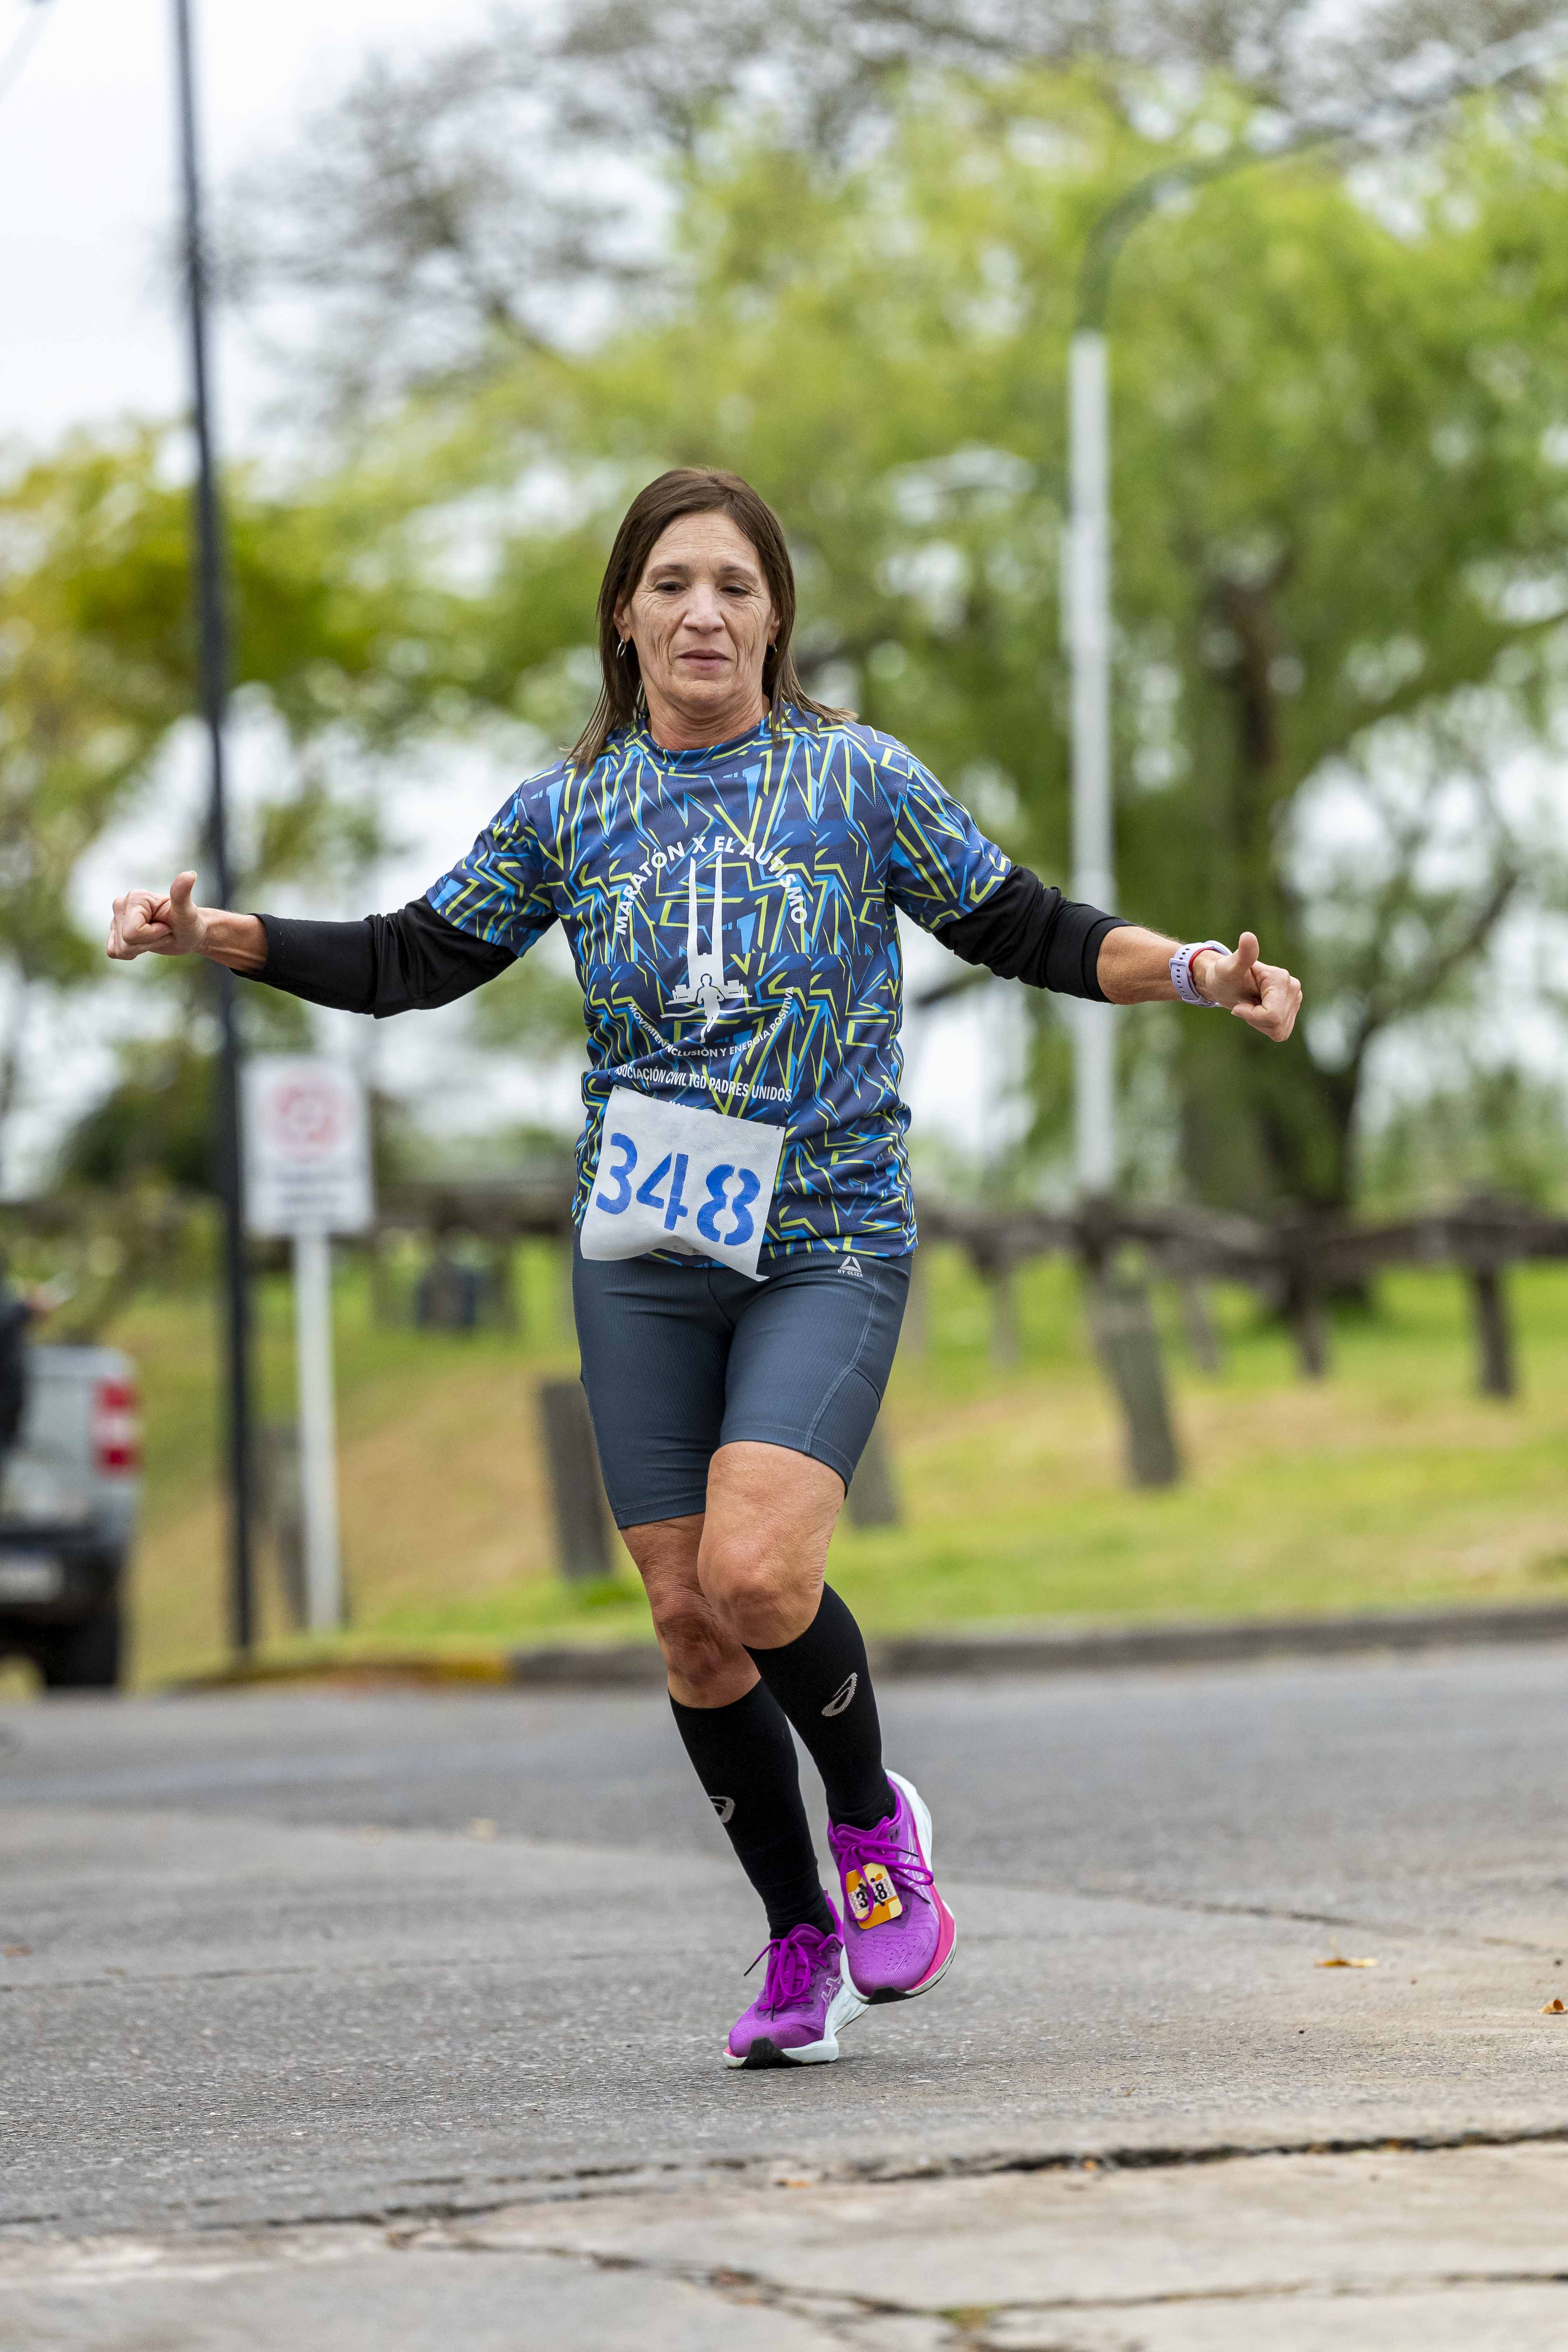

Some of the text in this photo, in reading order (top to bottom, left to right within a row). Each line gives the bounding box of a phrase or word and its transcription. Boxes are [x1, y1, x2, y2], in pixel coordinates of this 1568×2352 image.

[615, 836, 807, 935] MARATÓN X EL AUTISMO
[719, 1048, 726, 1057] Y
[729, 1030, 771, 1055] ENERGÍA
[769, 986, 794, 1032] POSITIVA
[665, 1071, 686, 1086] CIVIL
[689, 1073, 707, 1089] TGD
[709, 1077, 749, 1097] PADRES
[751, 1084, 792, 1102] UNIDOS
[595, 1132, 761, 1246] 348
[856, 1883, 887, 1908] 38
